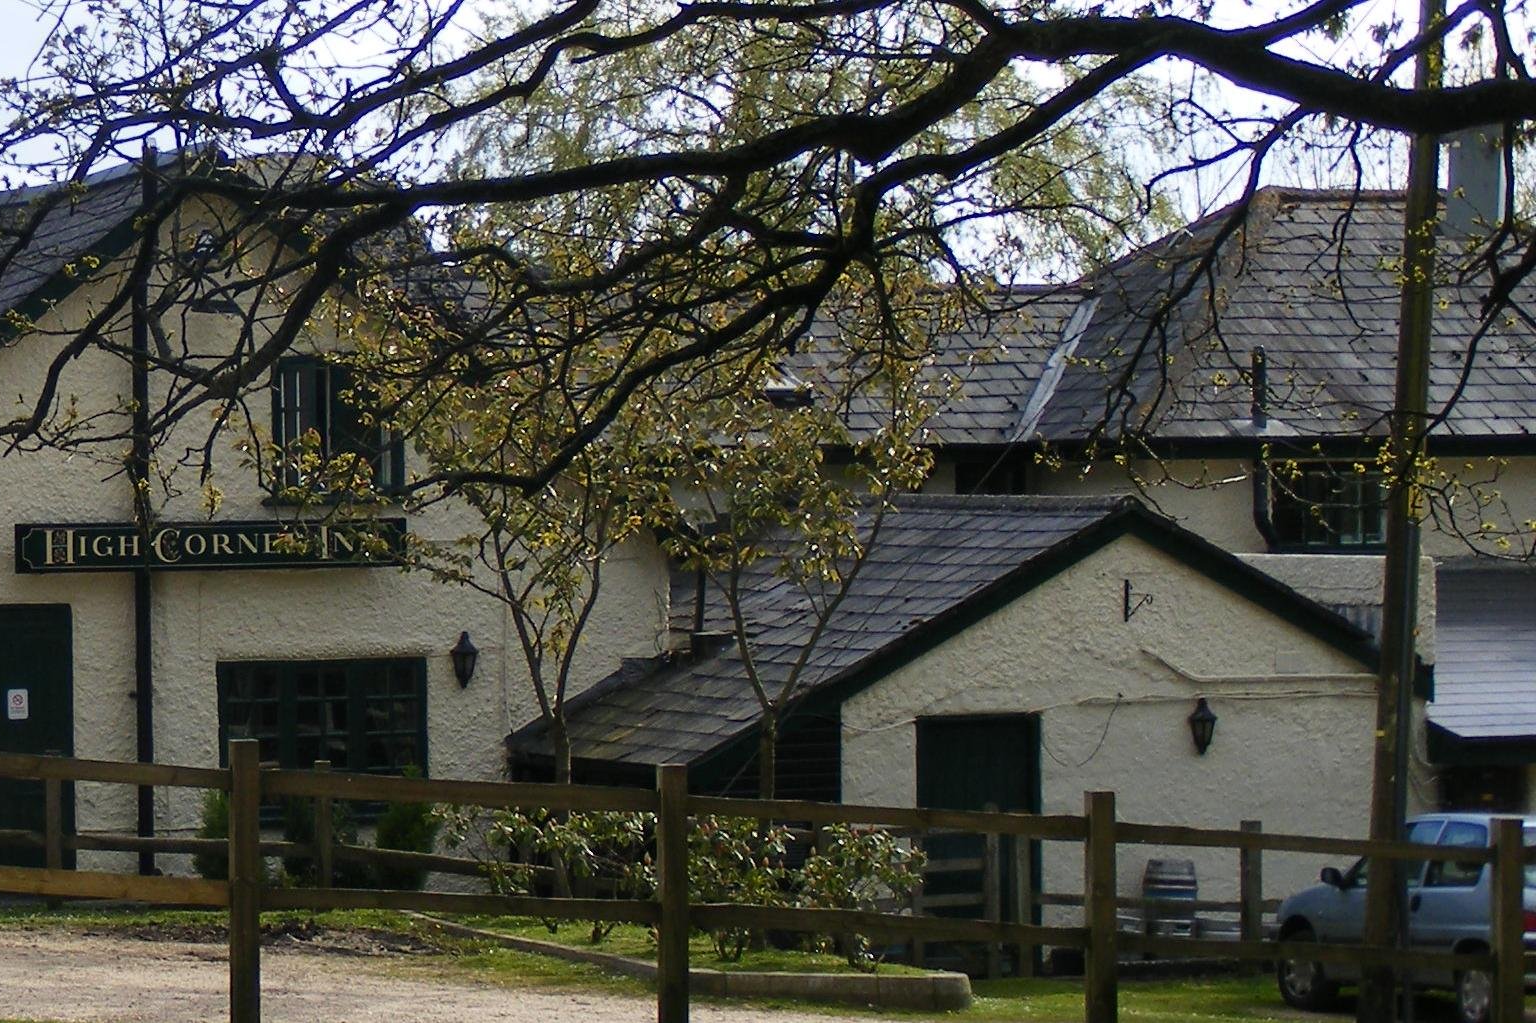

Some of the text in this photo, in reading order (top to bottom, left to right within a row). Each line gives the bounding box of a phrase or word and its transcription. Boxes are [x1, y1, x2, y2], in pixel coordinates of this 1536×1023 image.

[44, 525, 381, 564] HIGH CORNE IN
